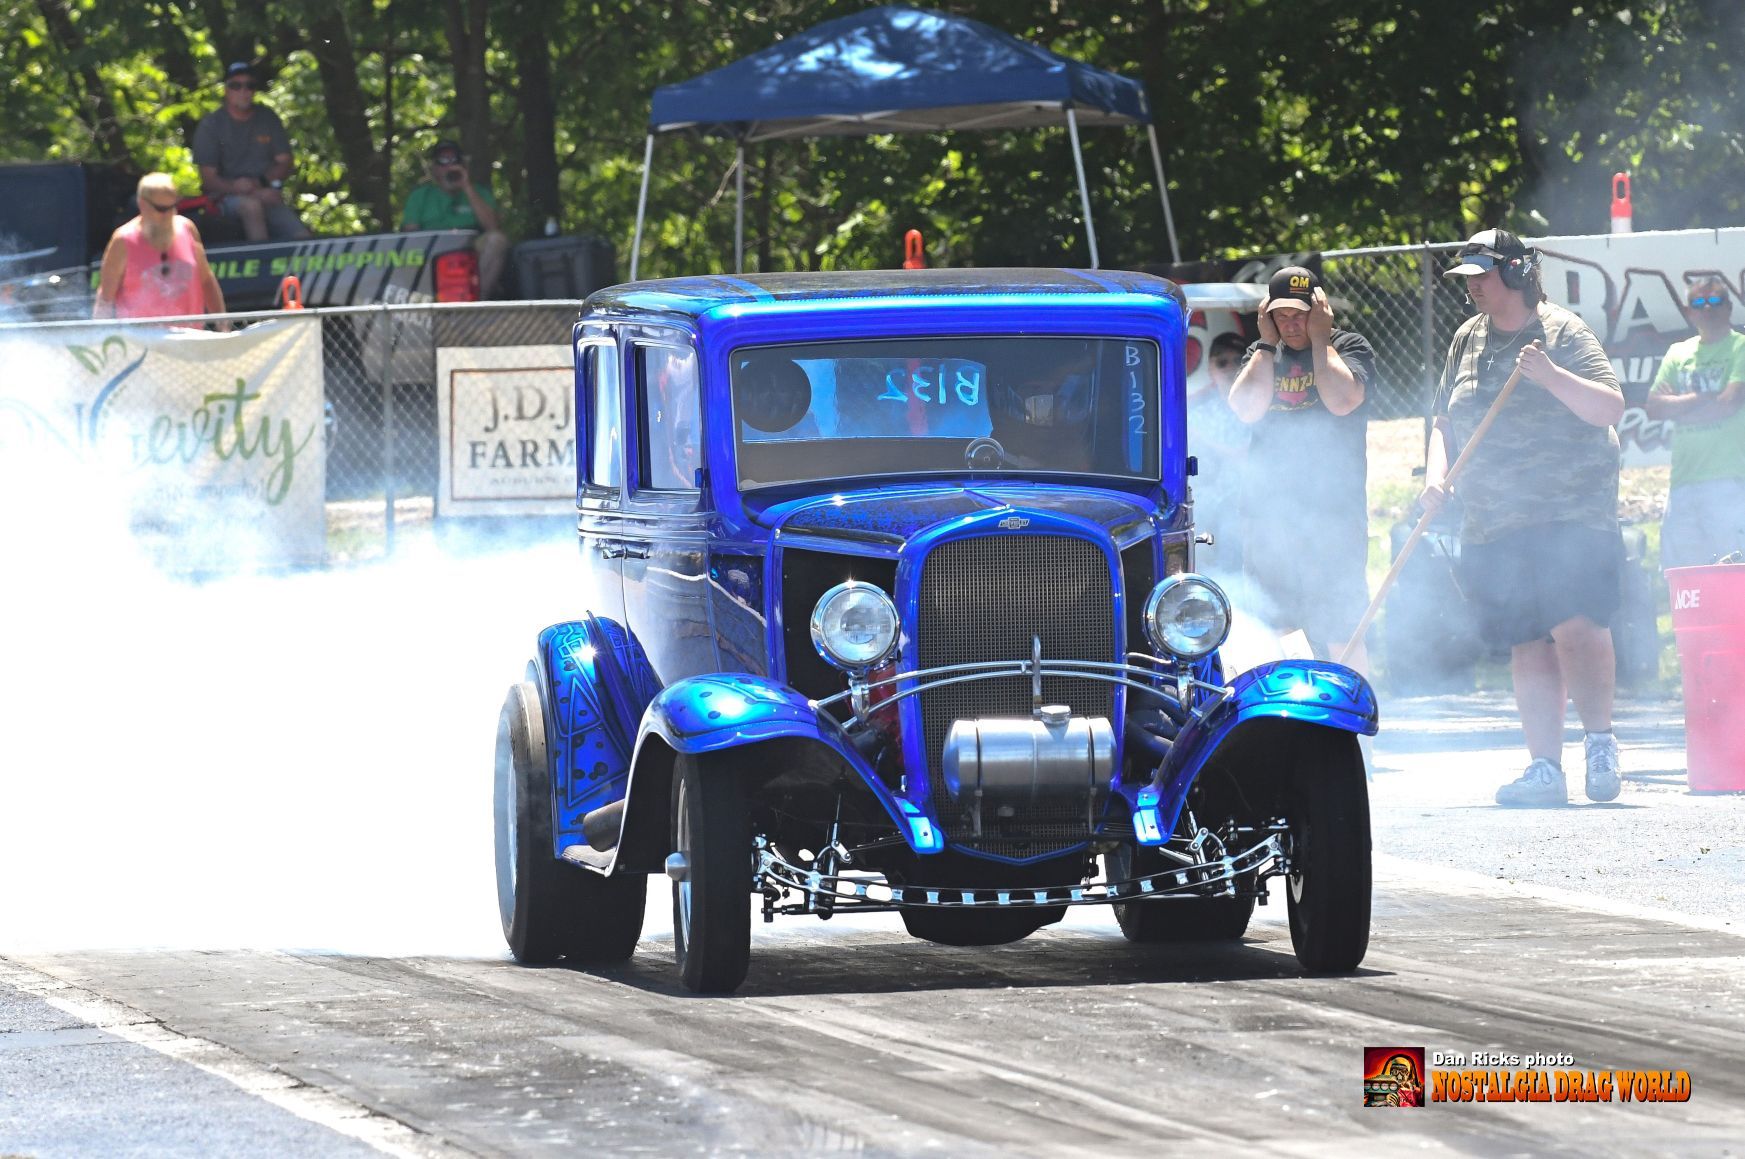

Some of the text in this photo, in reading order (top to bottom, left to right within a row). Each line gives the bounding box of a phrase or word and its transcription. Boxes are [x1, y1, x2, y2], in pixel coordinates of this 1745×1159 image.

[270, 248, 425, 277] STRIPPING
[1289, 275, 1310, 288] QM
[1124, 345, 1148, 434] B132
